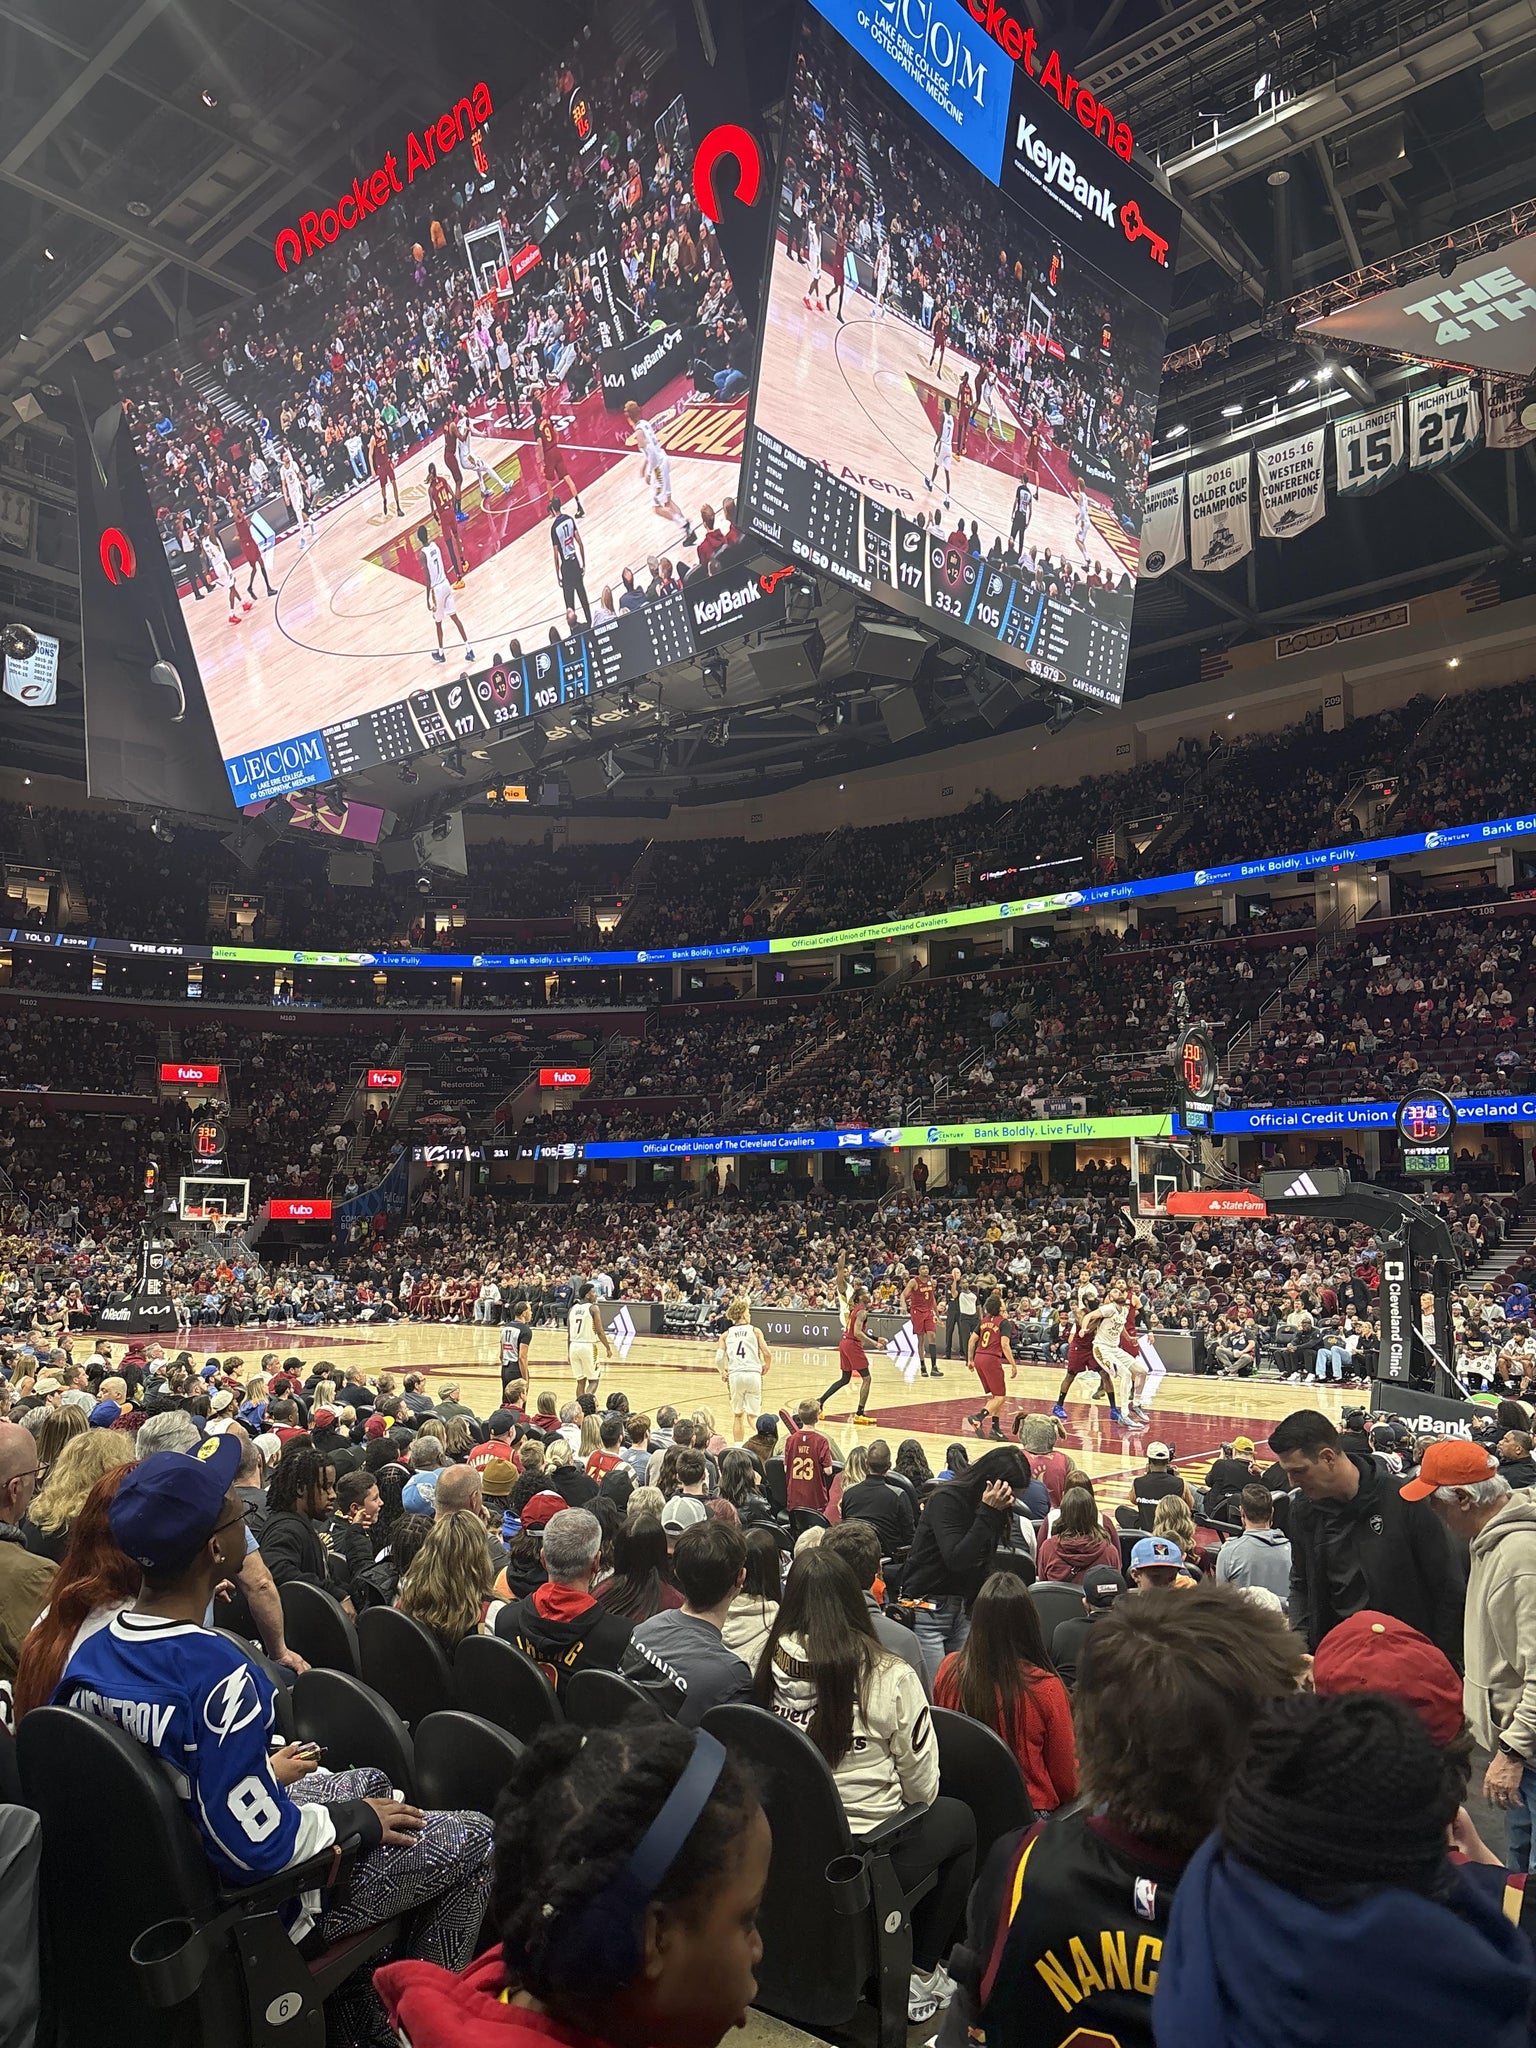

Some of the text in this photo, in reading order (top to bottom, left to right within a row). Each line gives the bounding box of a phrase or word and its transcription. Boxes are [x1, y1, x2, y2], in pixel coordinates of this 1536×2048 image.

[874, 10, 950, 97] LAKE ERIE COLLEGE
[857, 10, 964, 126] OF OSTEOPATHIC MEDICINE
[1040, 50, 1134, 163] Arena
[299, 81, 493, 257] Rocket Arena
[1016, 114, 1118, 229] KeyBank
[1402, 266, 1527, 324] THE
[1434, 287, 1536, 346] 4TH
[631, 342, 666, 380] KeyBank
[1417, 385, 1470, 412] MICHAYLUK
[1340, 411, 1397, 439] CALLANDER
[1418, 402, 1468, 457] 27
[1267, 441, 1314, 466] 2015-16
[1347, 427, 1392, 480] 15
[1206, 467, 1232, 485] 2016
[1269, 457, 1314, 481] WESTERN
[840, 466, 915, 502] Arena
[1150, 487, 1177, 501] DIVISION
[1192, 477, 1247, 505] CALDER CUP
[1262, 468, 1321, 497] CONFERENCE
[1193, 491, 1247, 520] CHAMPIONS
[1265, 483, 1319, 509] CHAMPIONS
[831, 562, 872, 592] RAFFLE
[900, 562, 922, 588] 117
[694, 580, 761, 625] KeyBank
[935, 591, 962, 617] 33.2
[977, 602, 1000, 628] 105
[1031, 659, 1060, 682] $9,979
[534, 687, 558, 708] 105
[1072, 678, 1121, 704] CAVS5050.COM
[1325, 697, 1340, 706] 209
[455, 715, 474, 735] 117
[494, 704, 519, 723] 33.2
[1439, 833, 1470, 843] CENTURY
[1482, 822, 1513, 837] Bank
[1241, 850, 1359, 876] Bank Boldly. Live Fully.
[1091, 887, 1135, 901] Live Fully.
[24, 933, 42, 943] TOL
[791, 917, 948, 949] Official Credit Union of The Cleveland Cavaliers
[129, 943, 183, 955] THE 4TH
[383, 956, 422, 966] Live Fully.
[556, 955, 571, 963] Live
[573, 955, 593, 964] Fully.
[672, 950, 689, 958] Bank
[691, 948, 714, 958] Boldly.
[716, 946, 731, 955] Live
[732, 945, 752, 955] Fully.
[178, 1068, 203, 1080] fubo
[554, 1072, 576, 1082] fubo
[1250, 1113, 1298, 1126] Official
[1301, 1110, 1344, 1125] Credit
[1347, 1109, 1388, 1122] Union
[1442, 1102, 1517, 1118] Ceveland
[974, 1122, 1096, 1138] Bank Boldly. Live Fully.
[445, 1149, 463, 1159] 117
[541, 1148, 557, 1157] 105
[642, 1136, 815, 1153] Official Credit Union of The Cleveland Cavaliers
[1417, 1147, 1449, 1155] TISSOT
[289, 1204, 313, 1215] fubo
[575, 1319, 583, 1334] 7
[767, 1322, 829, 1337] YOU GOT
[1389, 1282, 1402, 1377] Cleveland Clinic
[736, 1341, 746, 1359] 4
[981, 1331, 991, 1348] 9
[792, 1456, 814, 1480] 23
[227, 1775, 282, 1842] 8
[279, 1999, 289, 2017] 6
